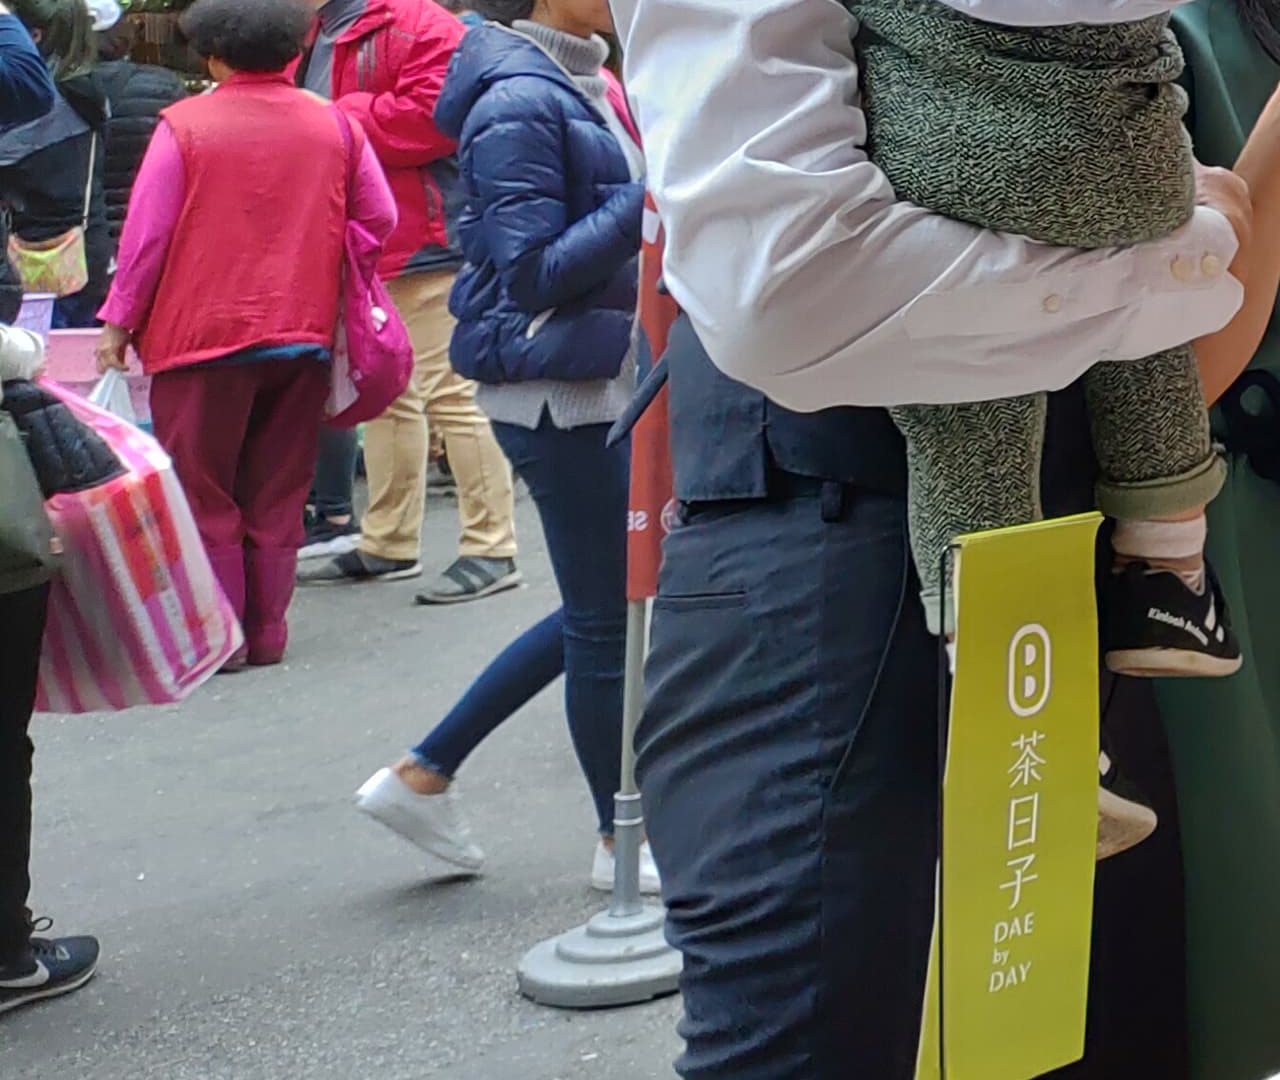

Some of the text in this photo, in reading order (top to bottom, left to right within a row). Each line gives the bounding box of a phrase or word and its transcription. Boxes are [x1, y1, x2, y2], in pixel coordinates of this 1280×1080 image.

[999, 729, 1047, 911] 茶日子
[993, 912, 1035, 944] DAE
[992, 947, 1010, 967] by
[988, 961, 1032, 993] DAY
